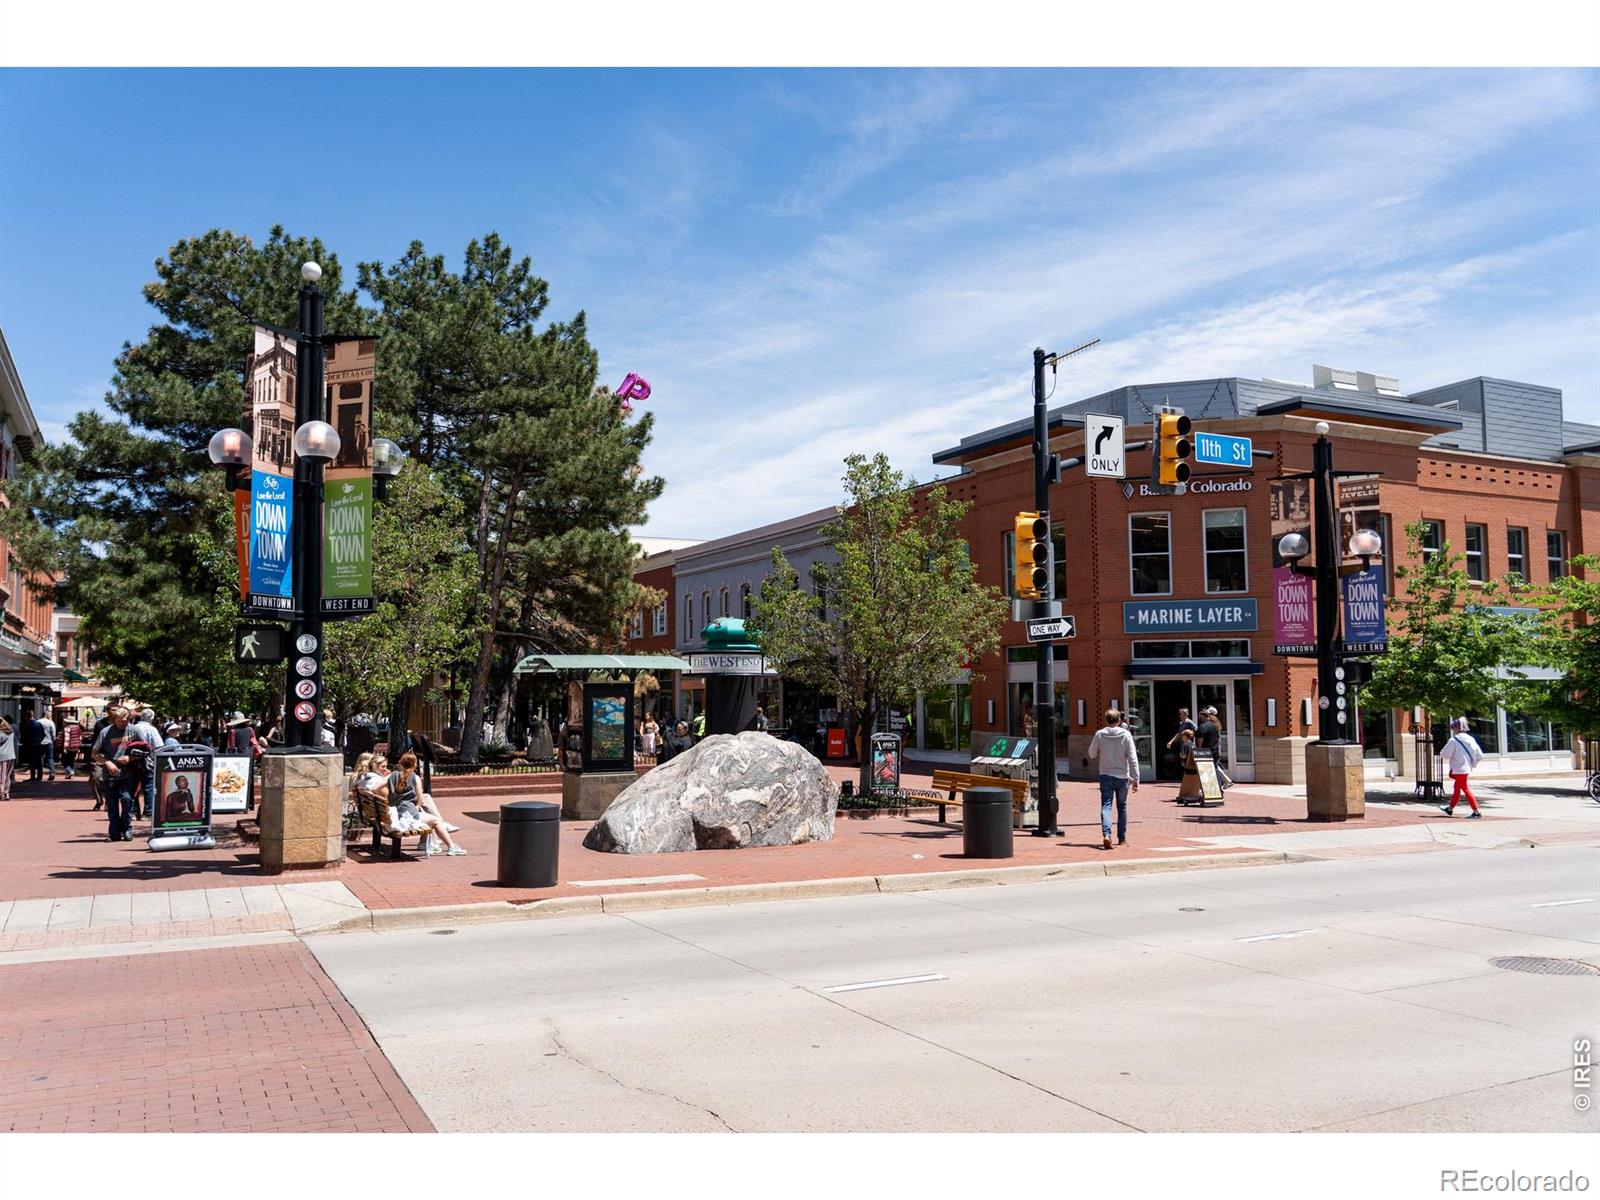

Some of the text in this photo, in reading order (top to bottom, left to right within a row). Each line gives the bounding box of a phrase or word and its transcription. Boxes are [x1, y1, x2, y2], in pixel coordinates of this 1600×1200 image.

[1201, 439, 1246, 461] 11th St
[1091, 458, 1120, 471] ONLY
[1190, 478, 1252, 493] Colorado
[255, 500, 286, 533] DOWN
[329, 506, 365, 535] DOWN
[255, 529, 286, 562] TOWN
[329, 534, 365, 563] TOWN
[1278, 585, 1308, 603] DOWN
[1348, 583, 1378, 602] DOWN
[252, 595, 291, 609] DOWNTOWN
[325, 598, 369, 610] WEST END
[1138, 608, 1193, 624] MARINE
[1198, 607, 1243, 622] LAYER
[1278, 603, 1308, 622] TOWN
[1348, 602, 1379, 621] TOWN
[1032, 624, 1060, 635] ONE WAY
[1276, 645, 1314, 653] DOWNTOWN
[1347, 643, 1384, 651] WEST END
[691, 658, 708, 666] THE
[708, 656, 741, 667] WEST
[741, 657, 760, 666] END
[177, 757, 204, 765] ANA'S
